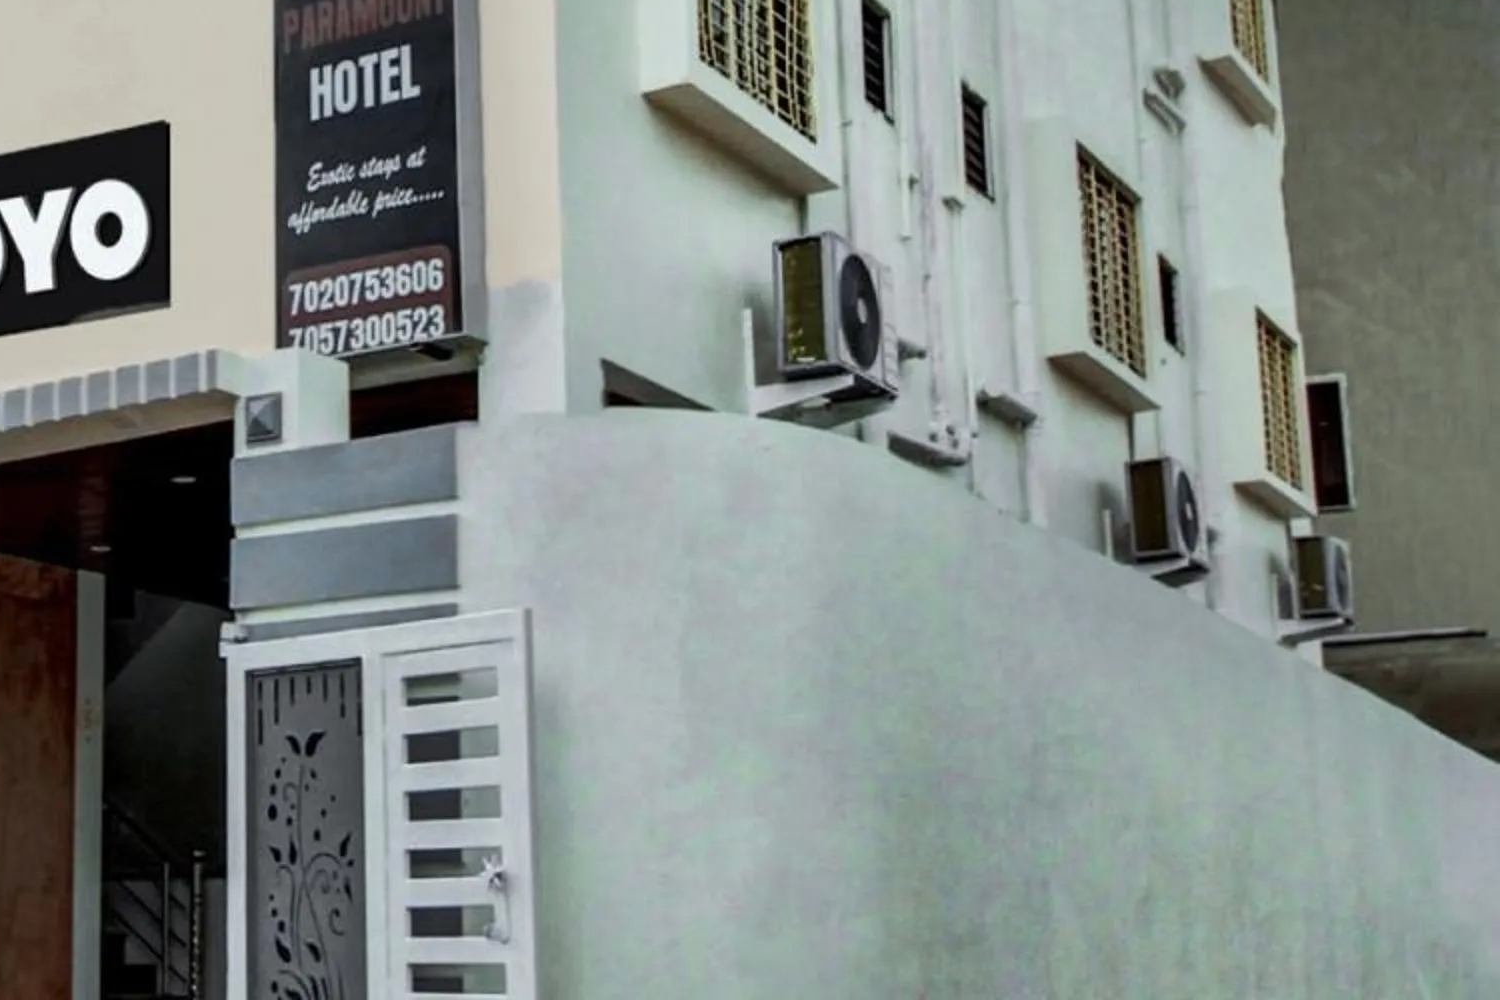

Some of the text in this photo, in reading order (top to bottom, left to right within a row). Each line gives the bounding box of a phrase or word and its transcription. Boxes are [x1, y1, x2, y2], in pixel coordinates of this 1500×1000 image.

[309, 44, 421, 122] HOTEL
[306, 146, 427, 192] Exotic stays at
[287, 188, 370, 235] affordable
[288, 258, 444, 317] 7020753606
[288, 304, 445, 355] 7057300523
